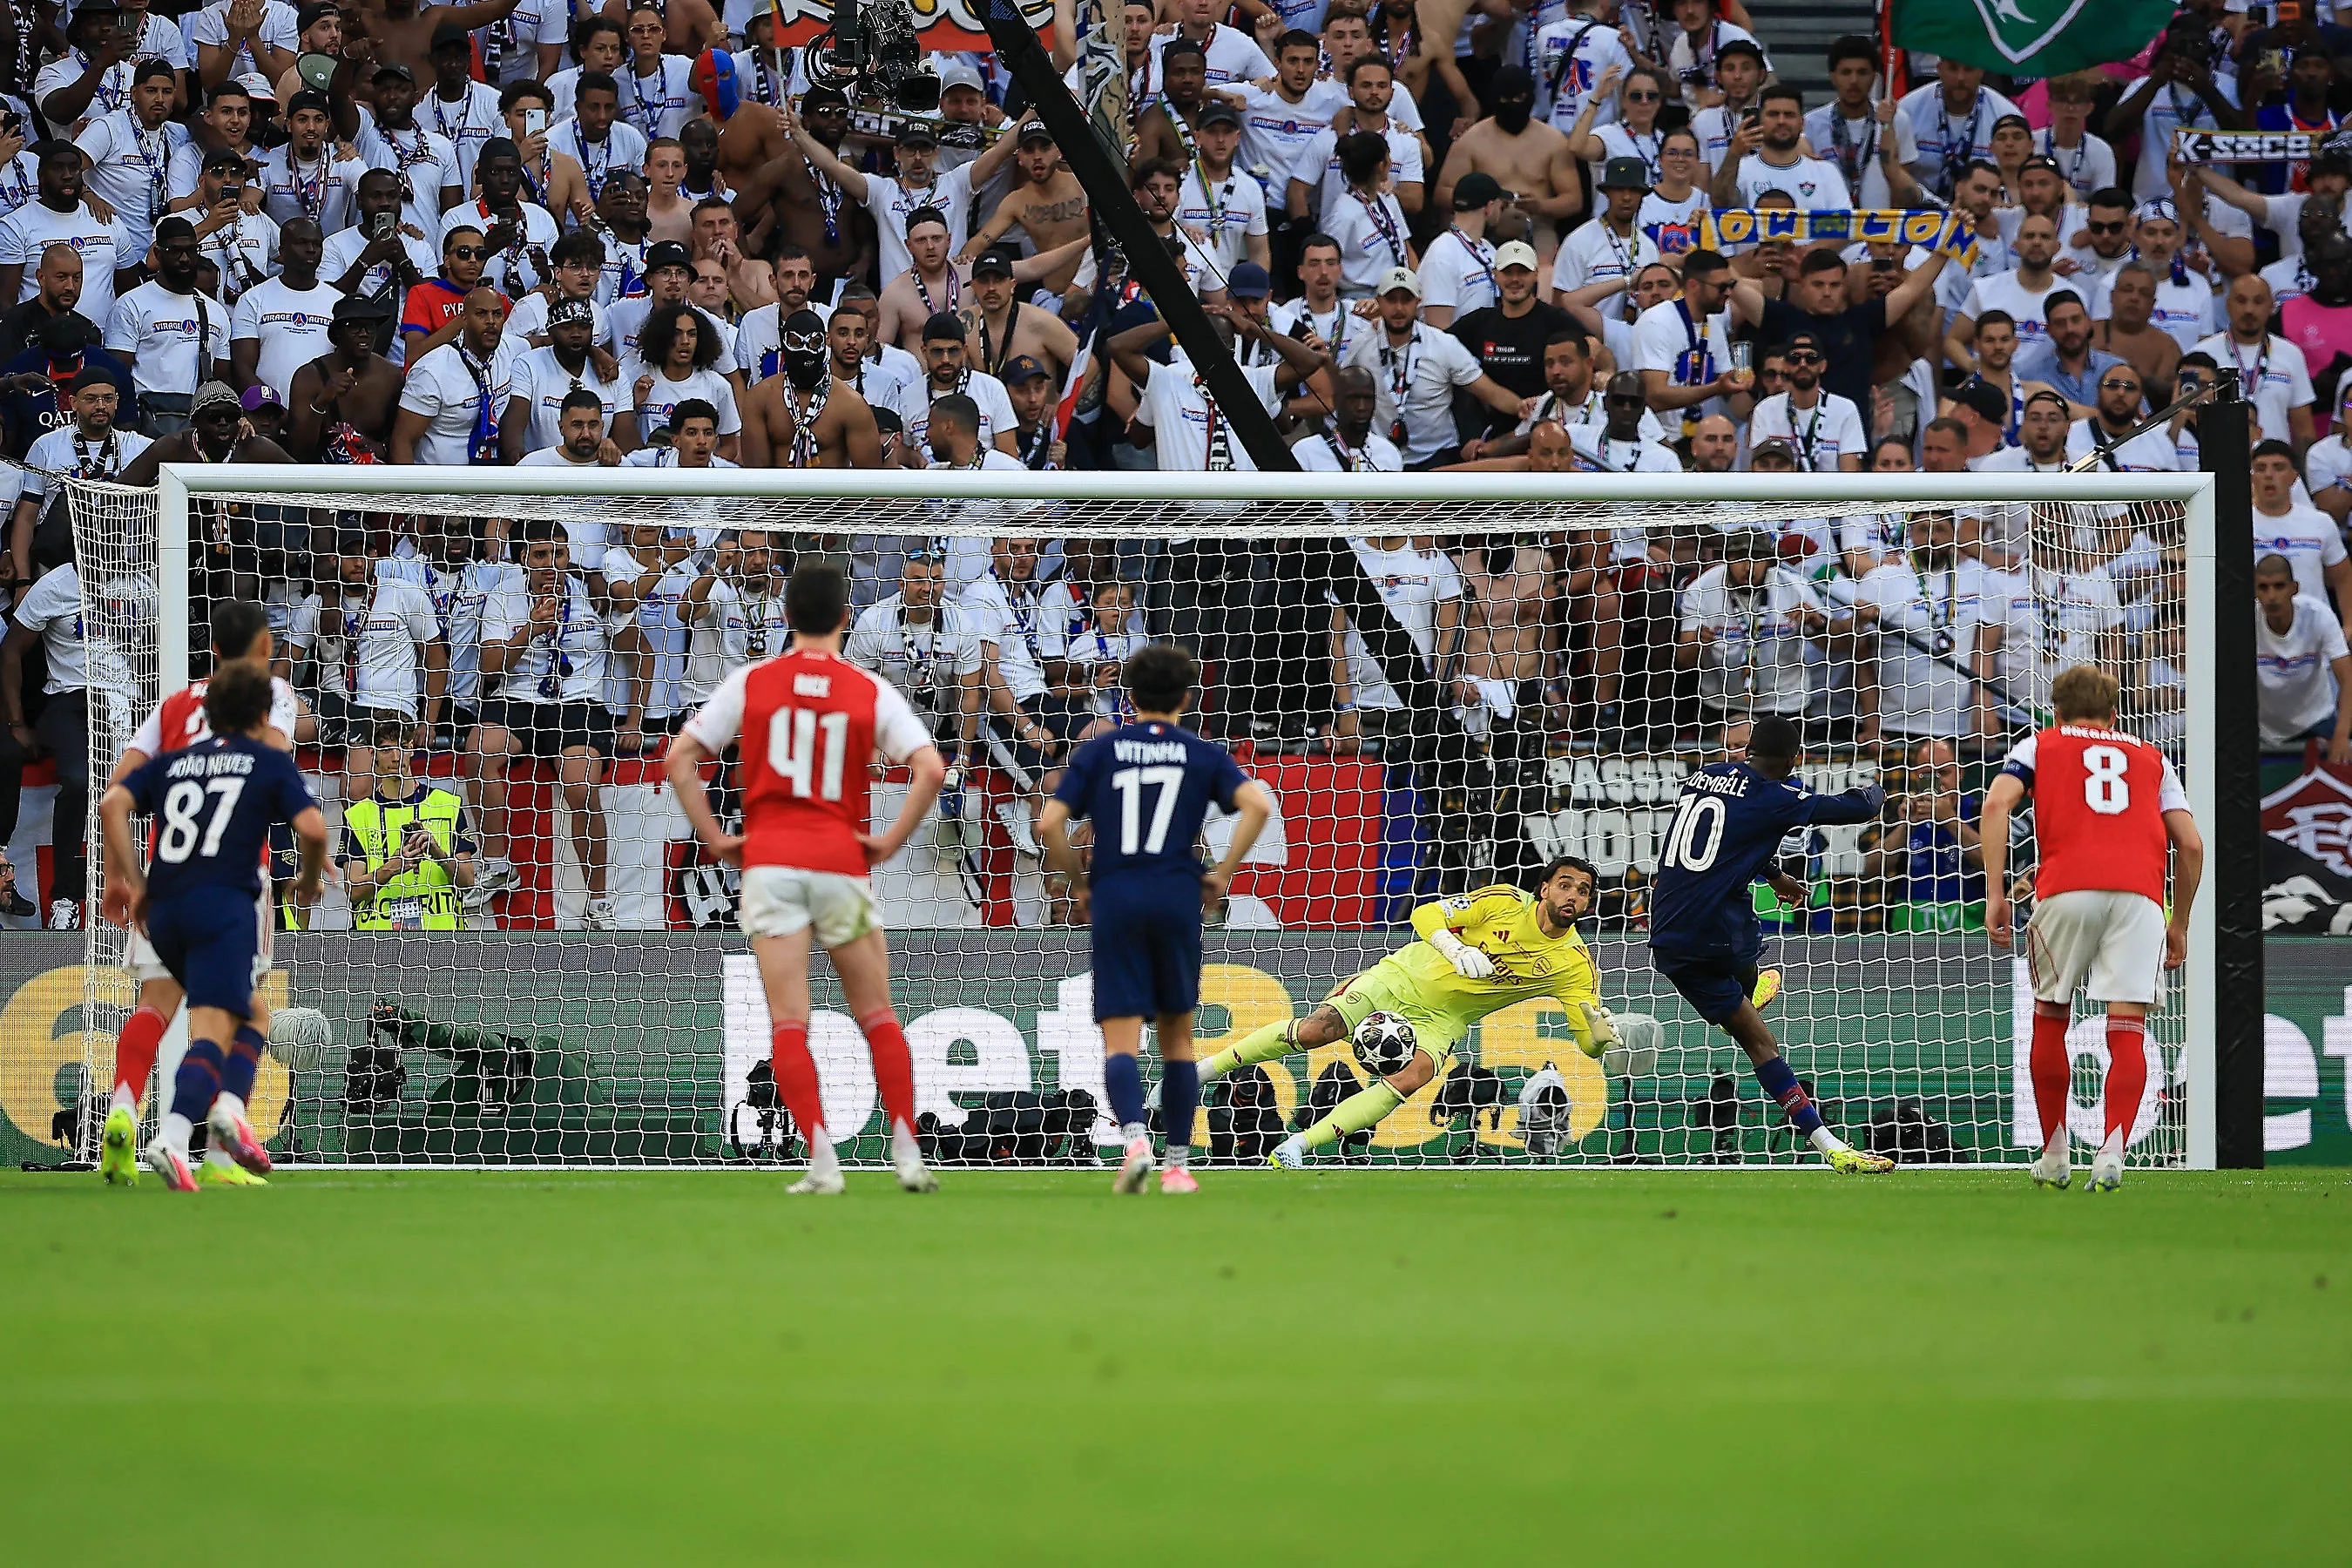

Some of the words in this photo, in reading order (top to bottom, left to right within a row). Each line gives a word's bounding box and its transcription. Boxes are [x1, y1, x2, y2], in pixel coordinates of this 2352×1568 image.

[85, 236, 113, 247] AUTEUIL
[155, 322, 181, 331] VIRAGE
[262, 314, 292, 323] VIRAGE
[166, 752, 207, 778] JOÃO
[768, 706, 850, 801] 41
[1113, 740, 1188, 765] VITINHA
[2083, 745, 2130, 815] 8
[158, 776, 247, 865] 87
[1112, 766, 1186, 855] 17
[1665, 792, 1727, 872] 10
